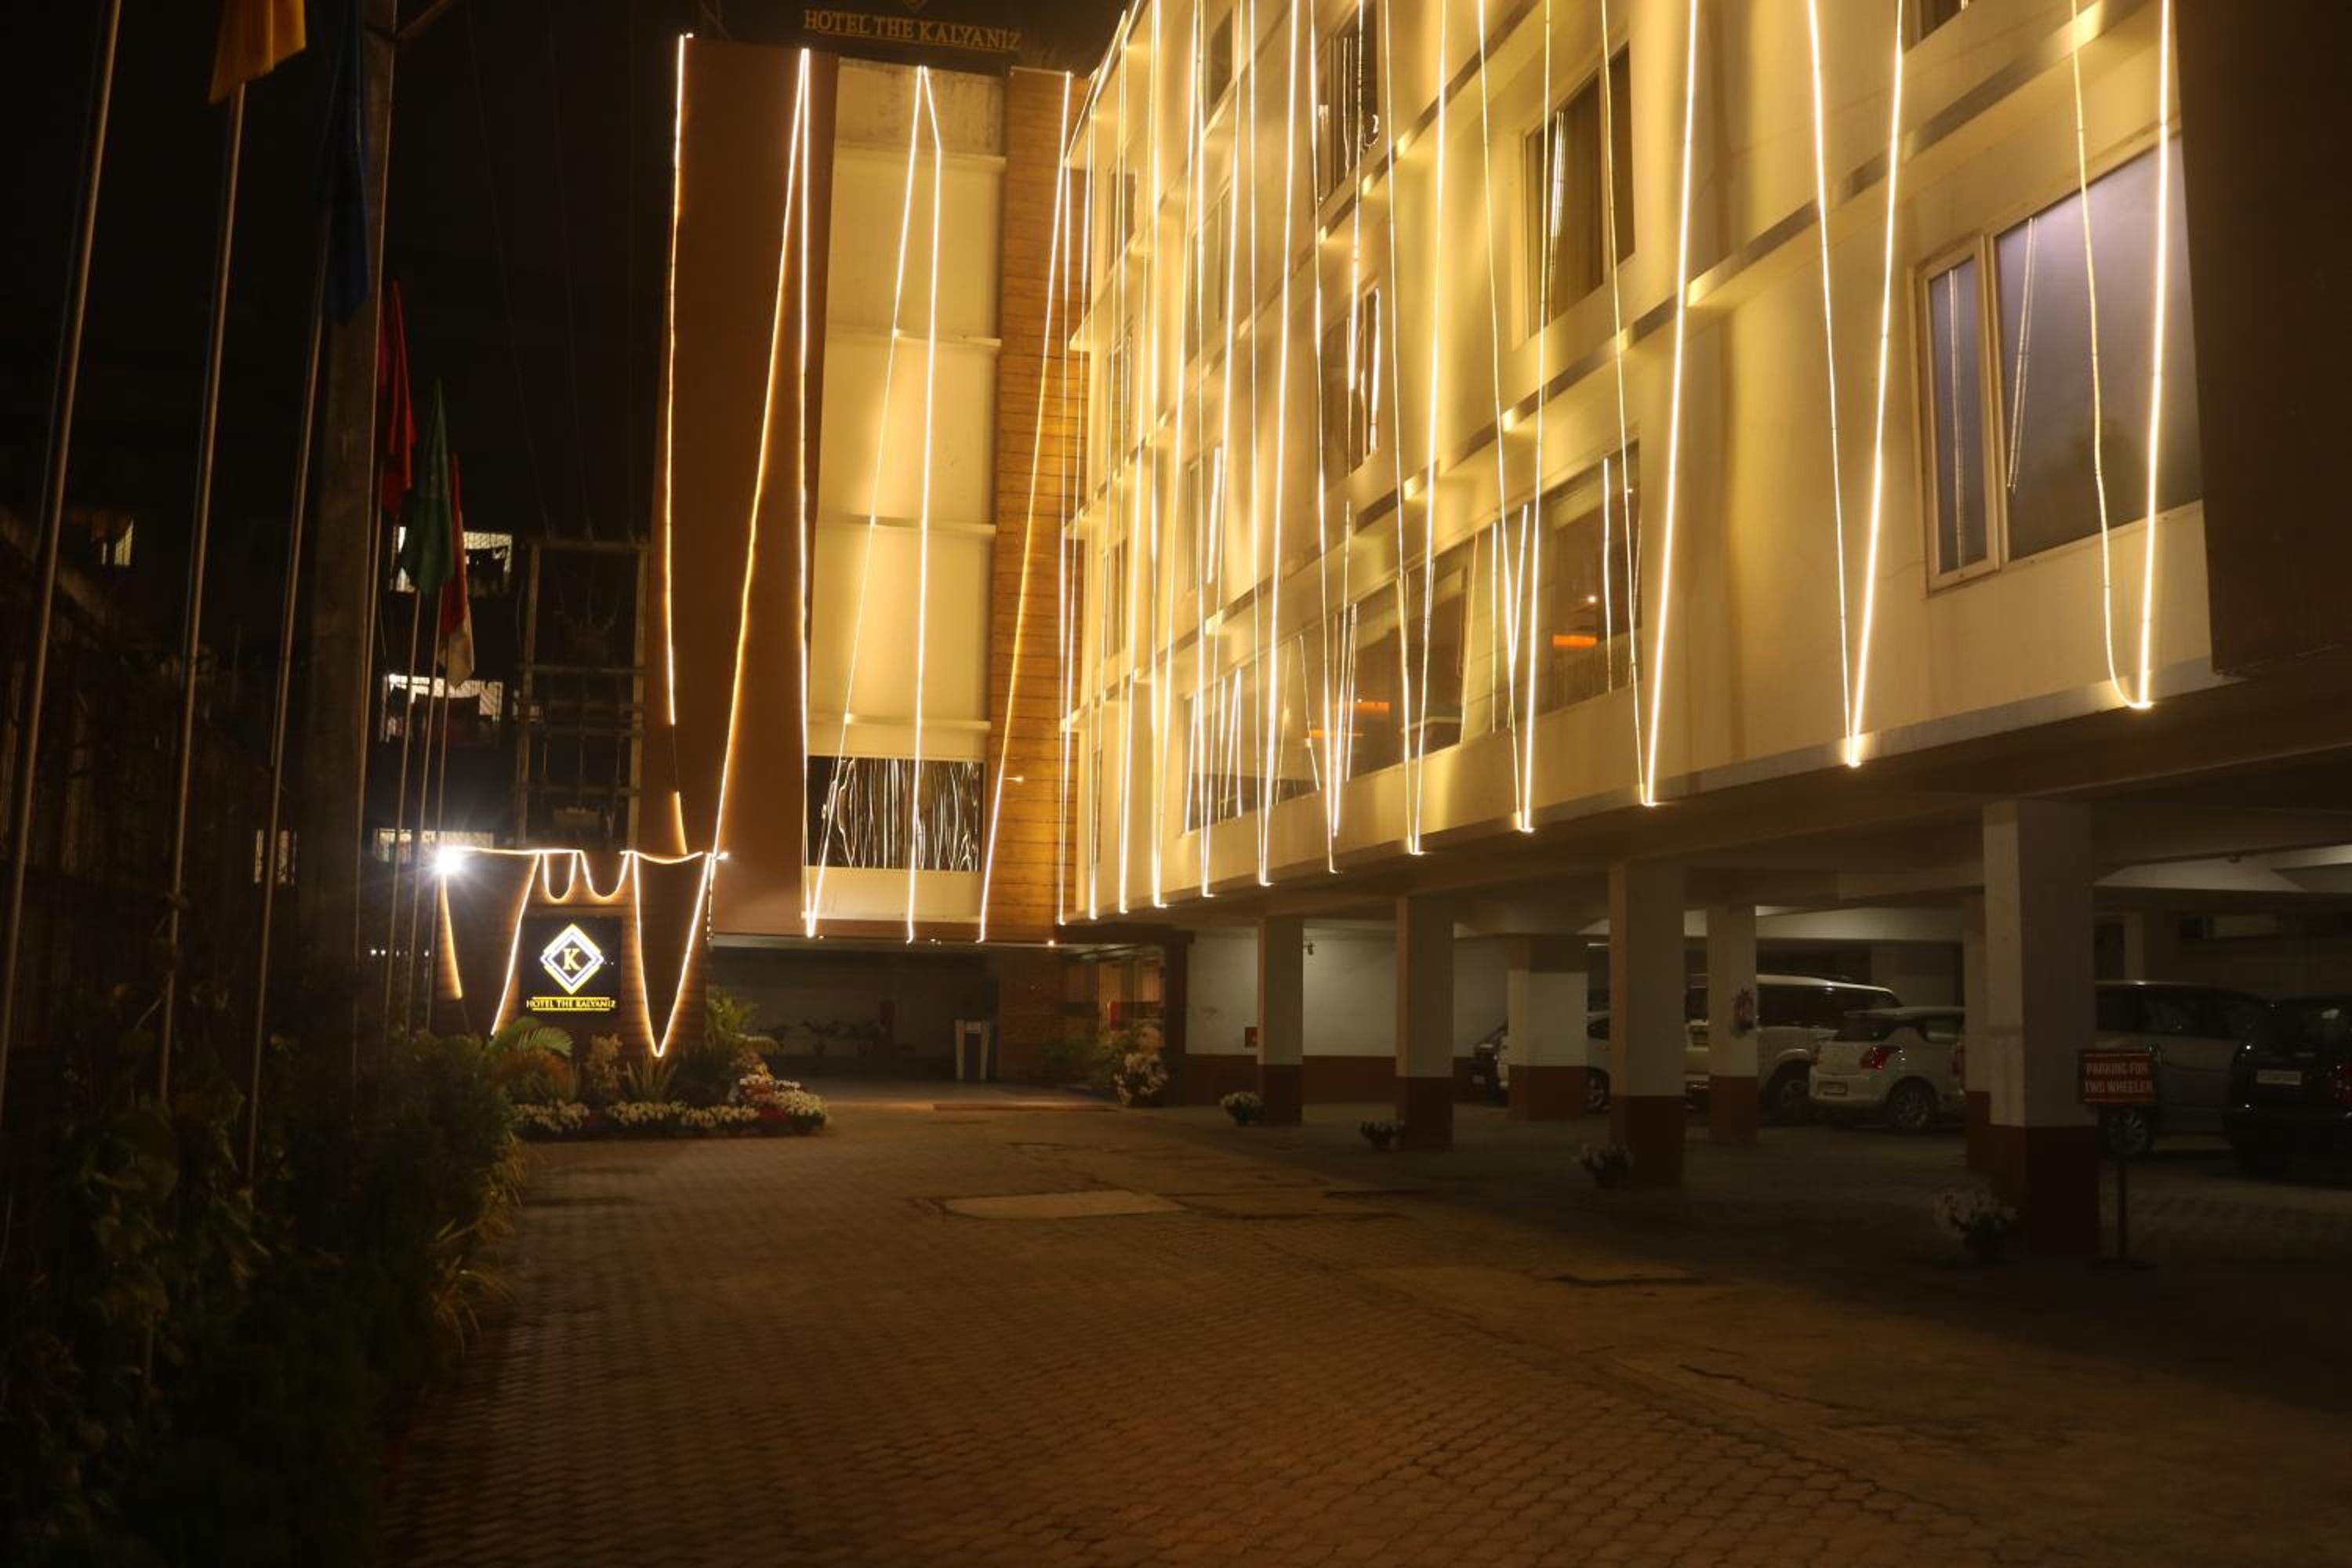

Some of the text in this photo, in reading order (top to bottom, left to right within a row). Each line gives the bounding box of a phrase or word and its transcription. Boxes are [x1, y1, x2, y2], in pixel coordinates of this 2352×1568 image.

[804, 9, 870, 34] HOTEL
[876, 15, 914, 38] THE
[563, 948, 581, 971] K
[526, 999, 554, 1008] HOTEL
[557, 999, 573, 1008] THE
[2085, 1061, 2149, 1075] PARKING FOR
[2084, 1080, 2106, 1093] TWO
